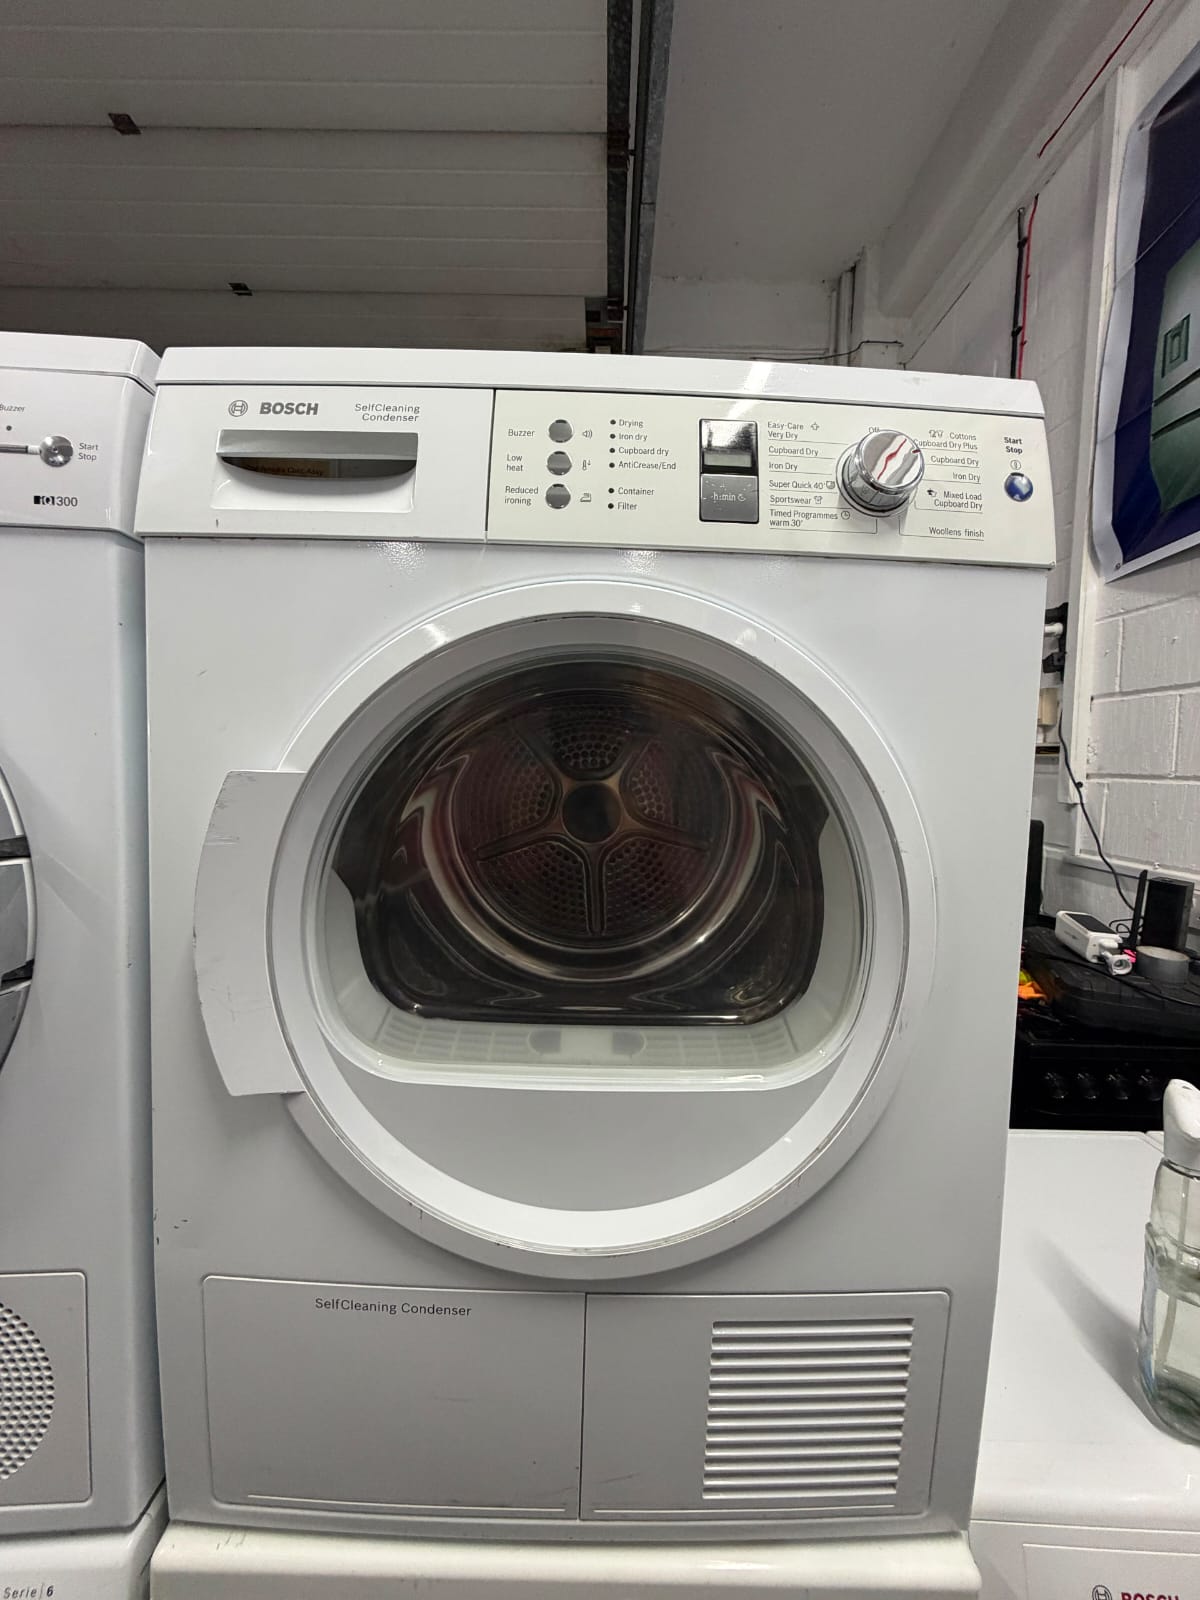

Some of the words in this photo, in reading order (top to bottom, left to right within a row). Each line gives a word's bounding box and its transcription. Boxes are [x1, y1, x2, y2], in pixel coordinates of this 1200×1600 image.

[259, 402, 319, 416] BOSCH
[355, 403, 420, 414] SelfCleaning
[362, 413, 419, 422] Condenser
[618, 419, 644, 428] Drying
[768, 422, 804, 430] Easy-Care
[508, 429, 535, 437] Buzzer
[619, 433, 633, 441] Iron
[635, 433, 648, 442] dry
[768, 430, 784, 440] Very
[785, 432, 798, 440] Dry
[950, 432, 977, 441] Cottons
[1004, 436, 1022, 445] Start
[79, 442, 99, 452] Start
[949, 441, 963, 451] Dry
[964, 441, 978, 450] Plus
[1005, 446, 1023, 455] Stop
[619, 447, 655, 456] Cupboard
[657, 448, 670, 457] dry
[769, 446, 804, 455] Cupboard
[806, 447, 819, 457] Dry
[78, 452, 97, 462] Stop
[506, 454, 522, 462] Low
[931, 455, 966, 465] Cupboard
[967, 457, 979, 467] Dry
[507, 464, 523, 472] heat
[618, 461, 676, 470] AntiCrease/End
[769, 462, 783, 470] Iron
[785, 462, 798, 472] Dry
[953, 472, 967, 480] Iron
[969, 473, 981, 483] Dry
[769, 480, 790, 488] Super
[792, 481, 812, 490] Quick
[505, 486, 539, 495] Reduced
[618, 487, 655, 496] Container
[944, 490, 964, 500] Mixed
[966, 491, 982, 501] Load
[504, 496, 532, 506] ironing
[770, 494, 812, 504] Sportswear
[618, 502, 638, 510] Filter
[934, 500, 968, 510] Cupboard
[970, 502, 983, 511] Dry
[770, 509, 792, 518] Timed
[793, 511, 838, 521] Programmes
[770, 519, 790, 527] warm
[929, 526, 962, 536] Woollens
[965, 528, 984, 537] finish
[315, 1298, 397, 1315] SelfCleaning
[401, 1303, 472, 1316] Condenser
